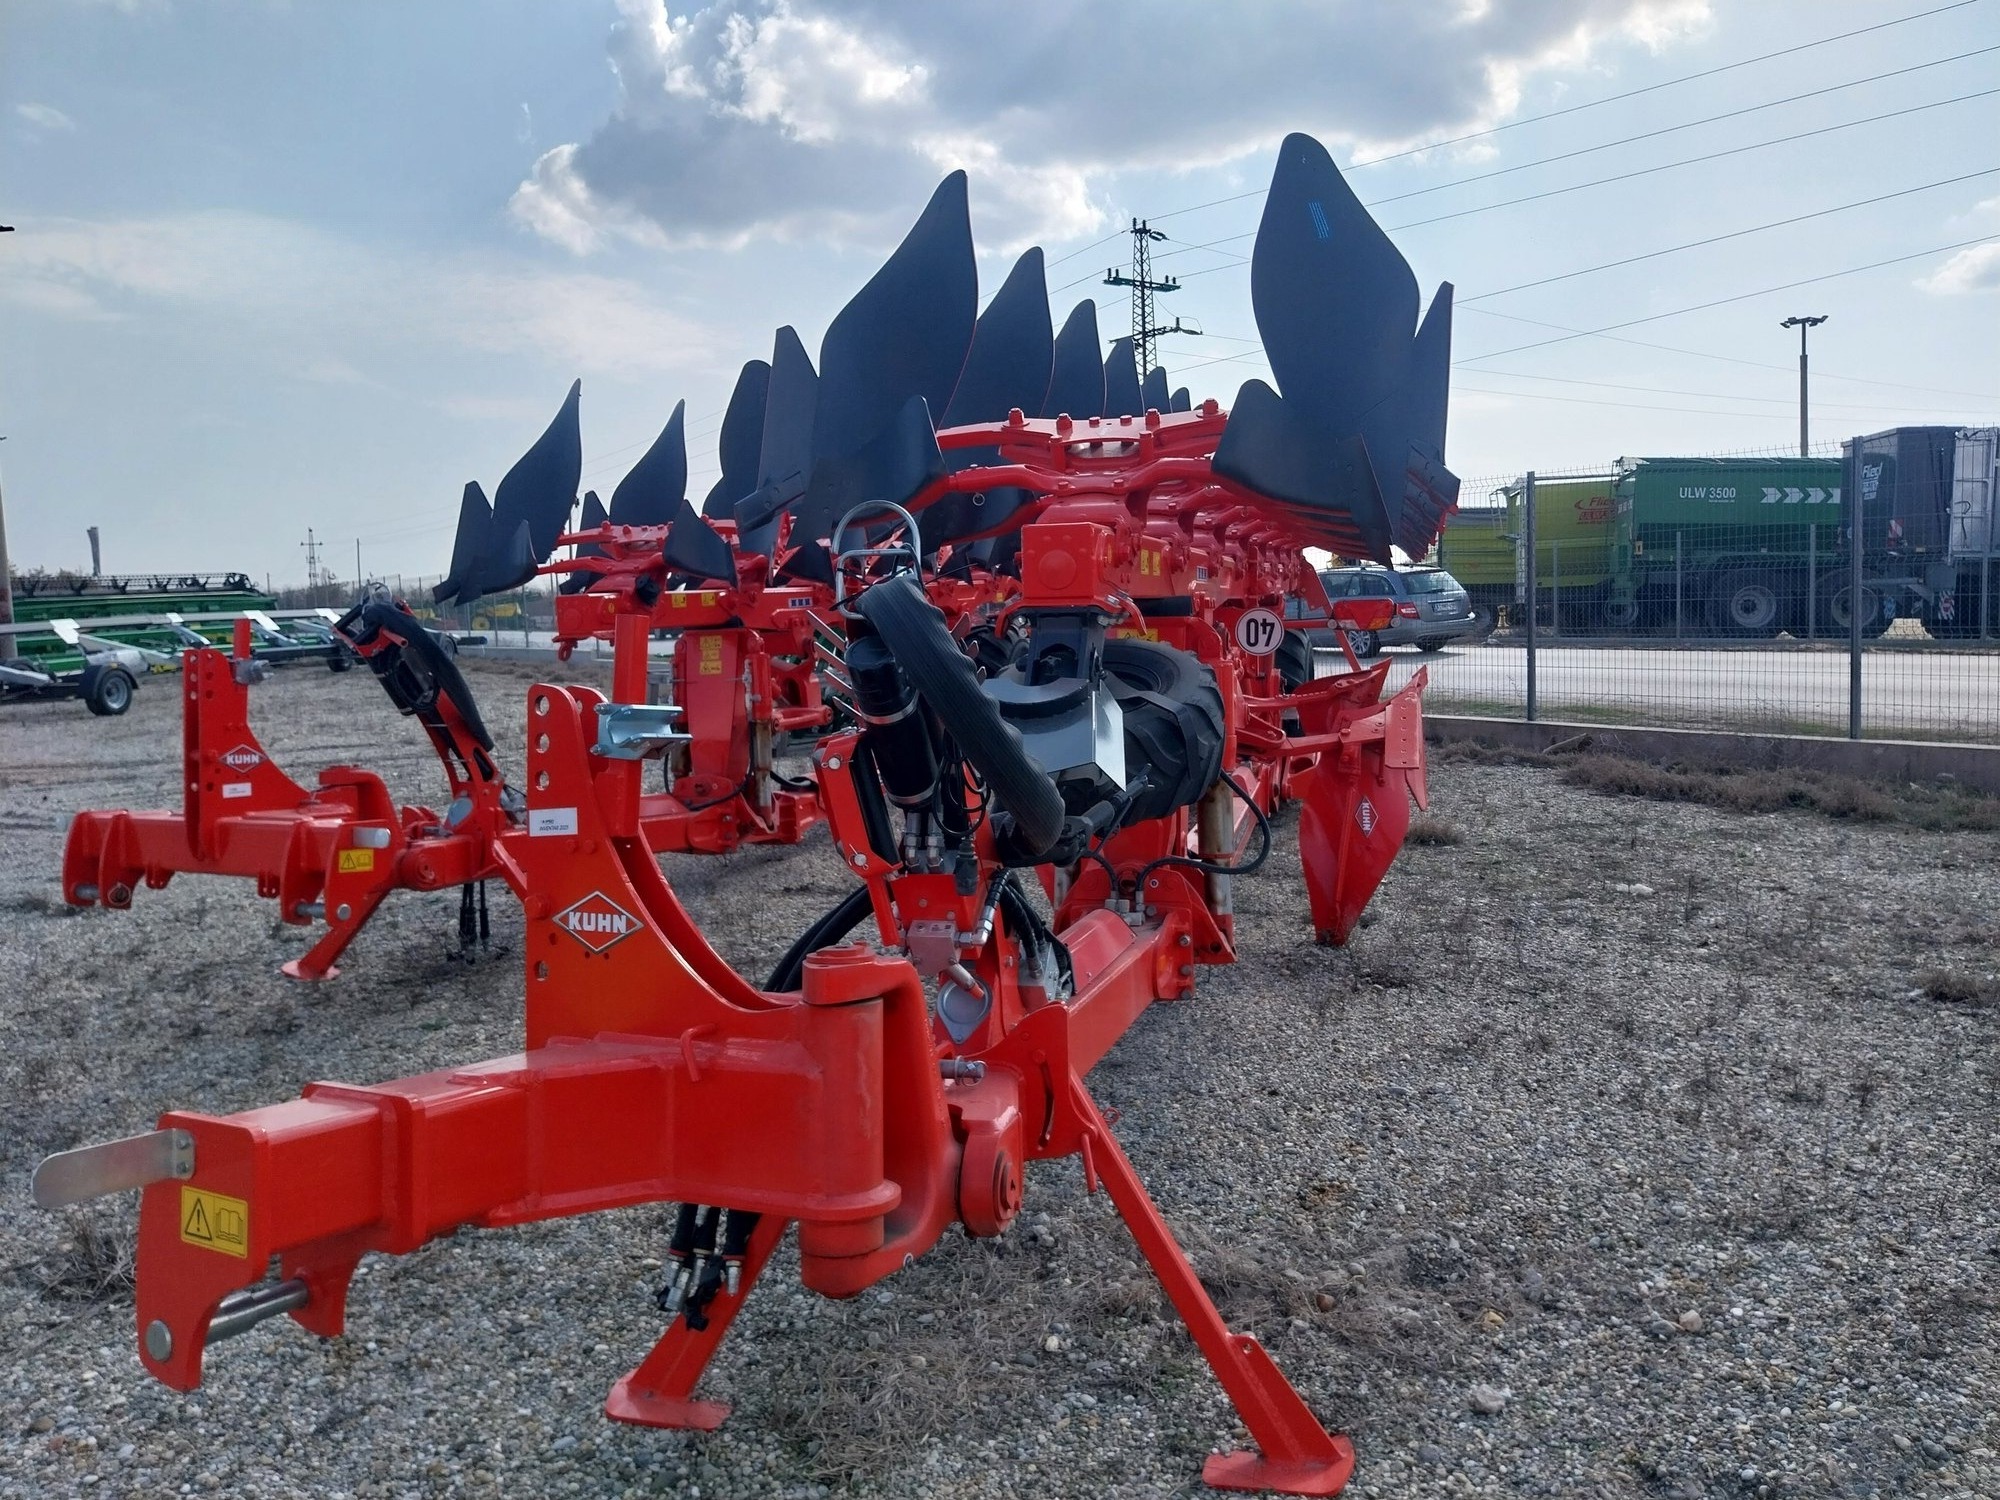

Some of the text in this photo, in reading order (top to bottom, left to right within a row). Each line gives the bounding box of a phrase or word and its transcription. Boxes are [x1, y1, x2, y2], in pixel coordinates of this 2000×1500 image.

[1679, 487, 1736, 499] ULW 3500
[1246, 618, 1275, 647] 40
[227, 754, 259, 764] KUHN
[1362, 802, 1371, 831] KUHN
[568, 911, 627, 933] KUHN
